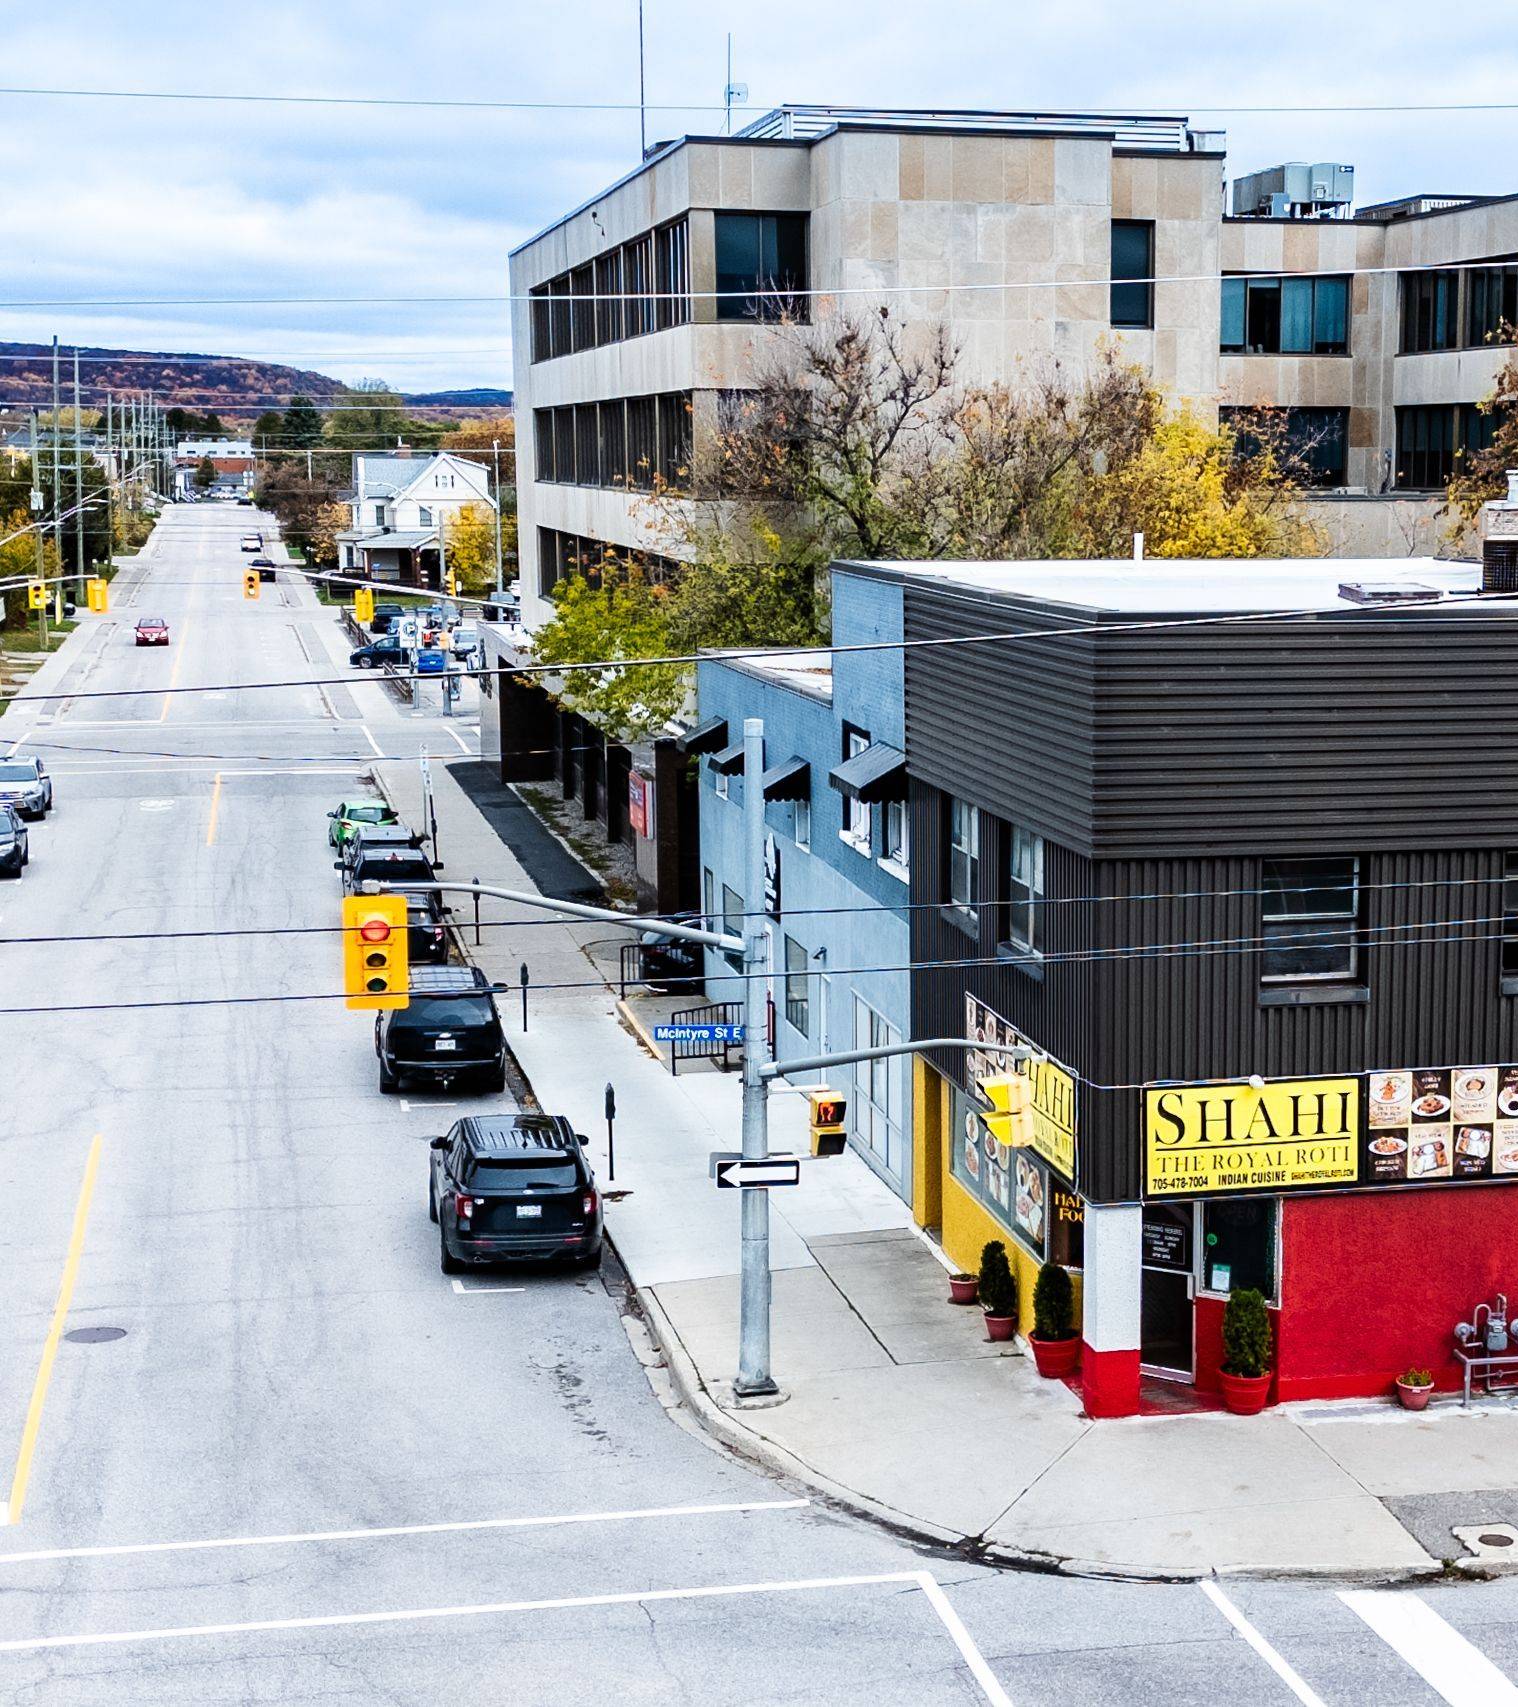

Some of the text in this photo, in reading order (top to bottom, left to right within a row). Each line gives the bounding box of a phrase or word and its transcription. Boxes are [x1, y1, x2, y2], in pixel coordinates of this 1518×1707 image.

[657, 1027, 741, 1040] McIntyre St E
[1029, 1058, 1073, 1130] HAHI
[1155, 1092, 1352, 1145] SHAHI
[1156, 1146, 1349, 1172] THE ROYAL ROTI
[1218, 1173, 1248, 1185] INDIAN
[1251, 1171, 1286, 1183] CUISINE
